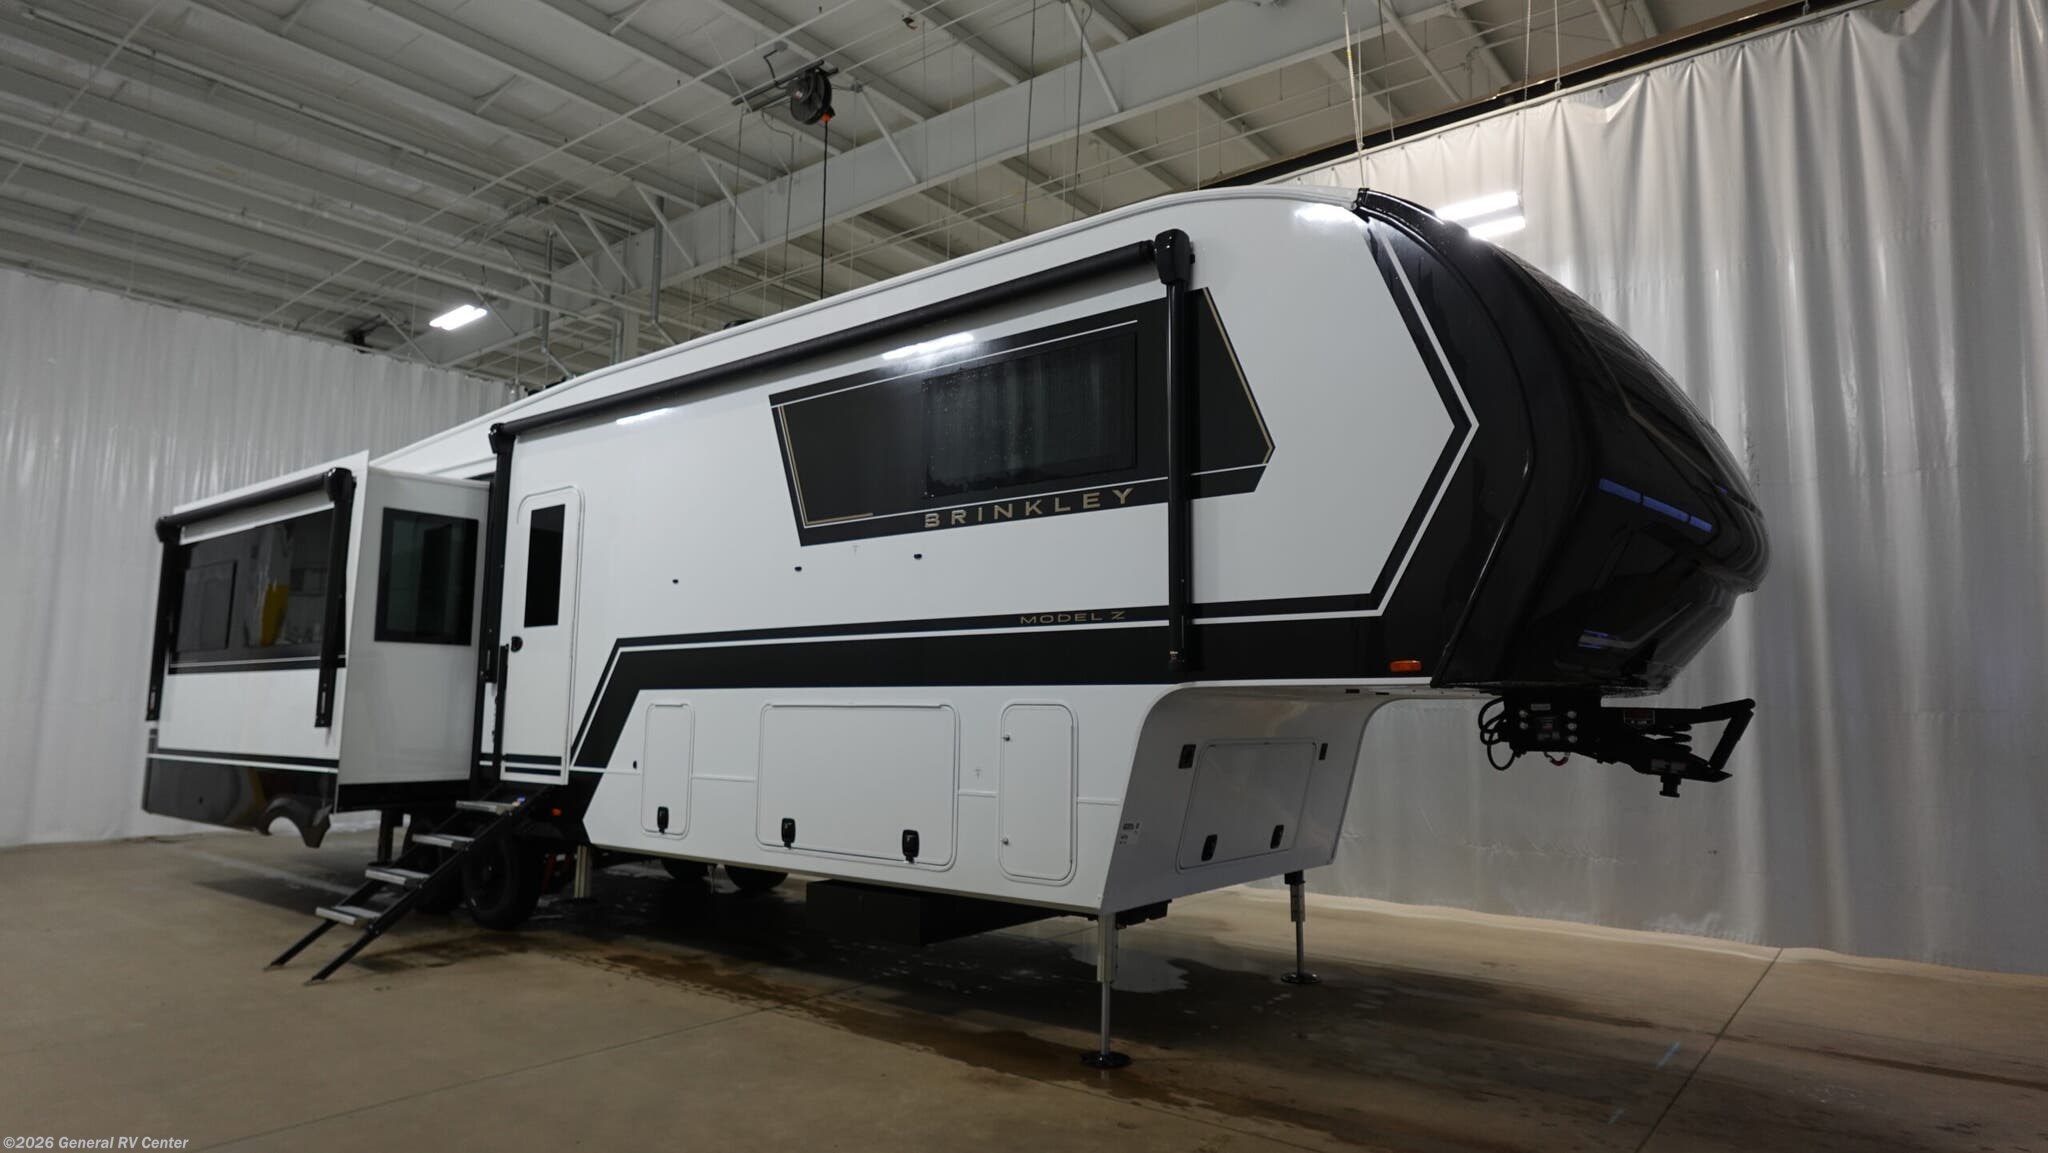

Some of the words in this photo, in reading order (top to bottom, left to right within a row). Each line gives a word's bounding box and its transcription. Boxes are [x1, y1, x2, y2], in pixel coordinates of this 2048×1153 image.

[924, 487, 1134, 529] BRINKLEY
[1019, 612, 1103, 624] MODEL
[1111, 610, 1126, 621] Z
